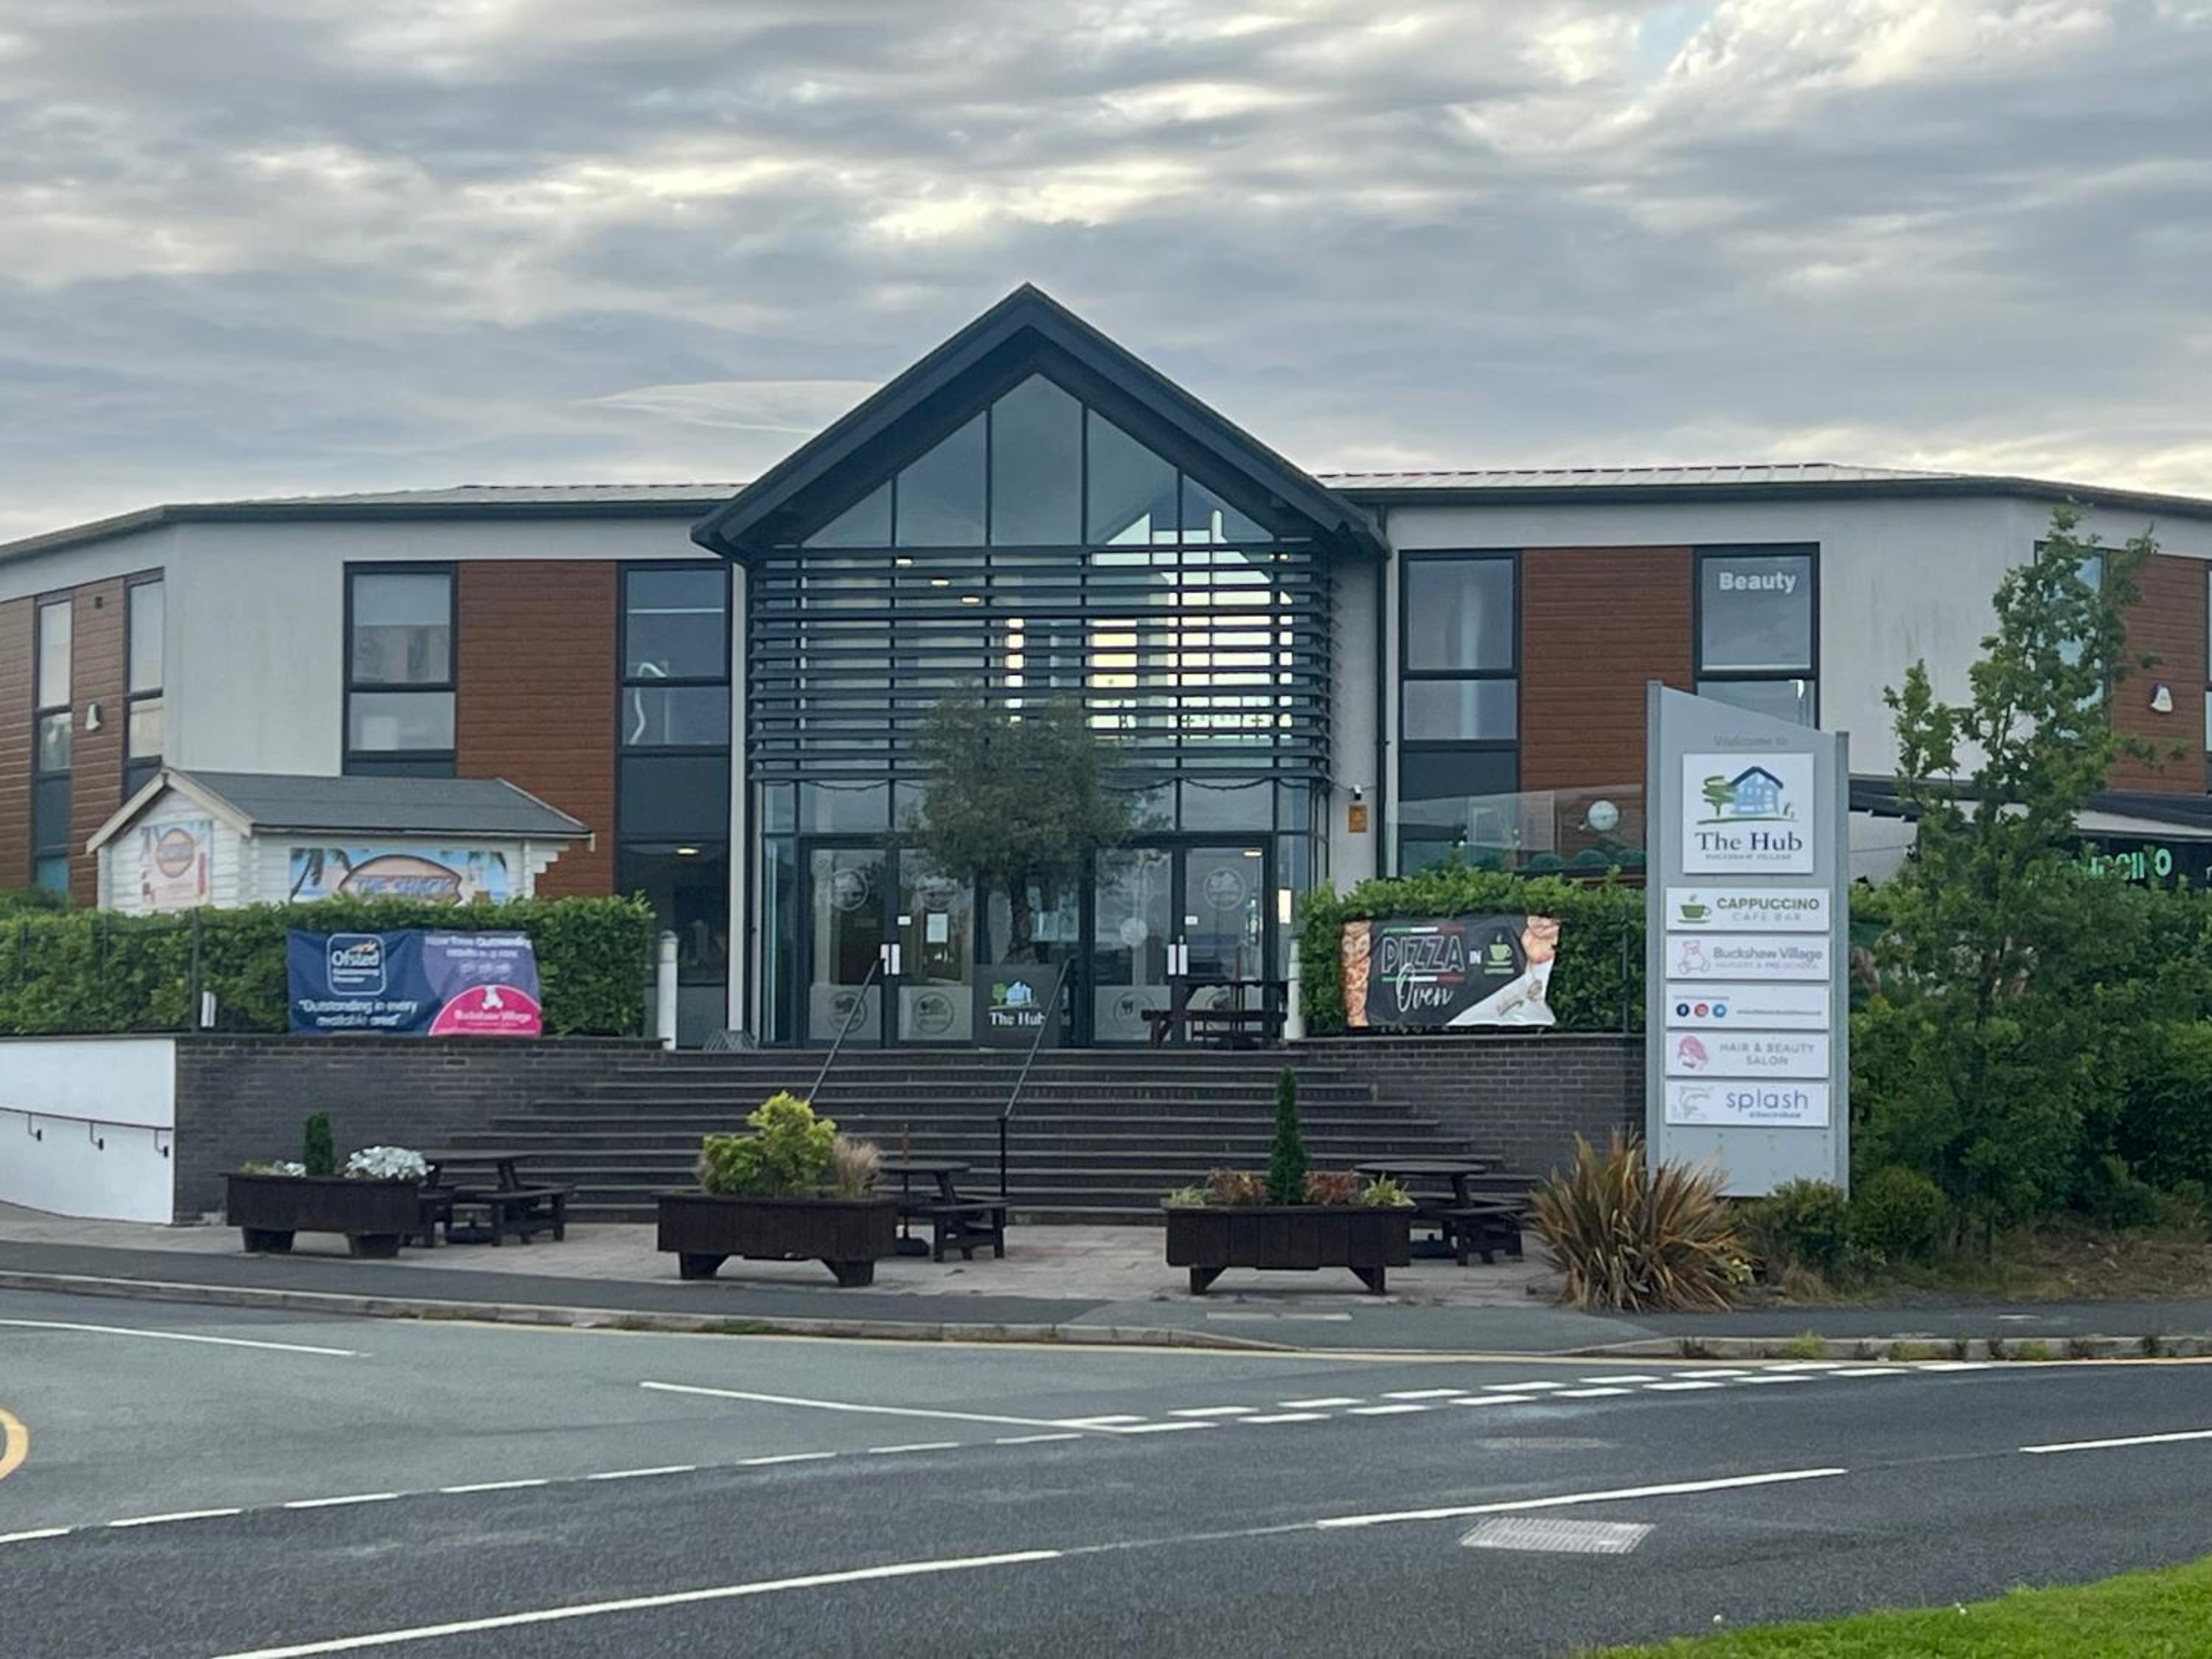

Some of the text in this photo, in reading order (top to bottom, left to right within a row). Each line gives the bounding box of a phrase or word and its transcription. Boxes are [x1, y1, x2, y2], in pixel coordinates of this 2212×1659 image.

[1719, 572, 1796, 594] Beauty
[1713, 734, 1773, 746] Welcome
[1694, 830, 1803, 850] The Hub
[1716, 897, 1820, 910] CAPPUCCINO
[1774, 913, 1801, 922] BAR
[1381, 935, 1465, 974] PIZZA
[1779, 947, 1823, 964] Village
[1396, 962, 1454, 1013] Oven
[989, 1011, 1046, 1026] The Hub
[1719, 1042, 1815, 1053] HAIR & BEAUTY
[1746, 1055, 1789, 1065] SALON
[1726, 1088, 1809, 1113] splash
